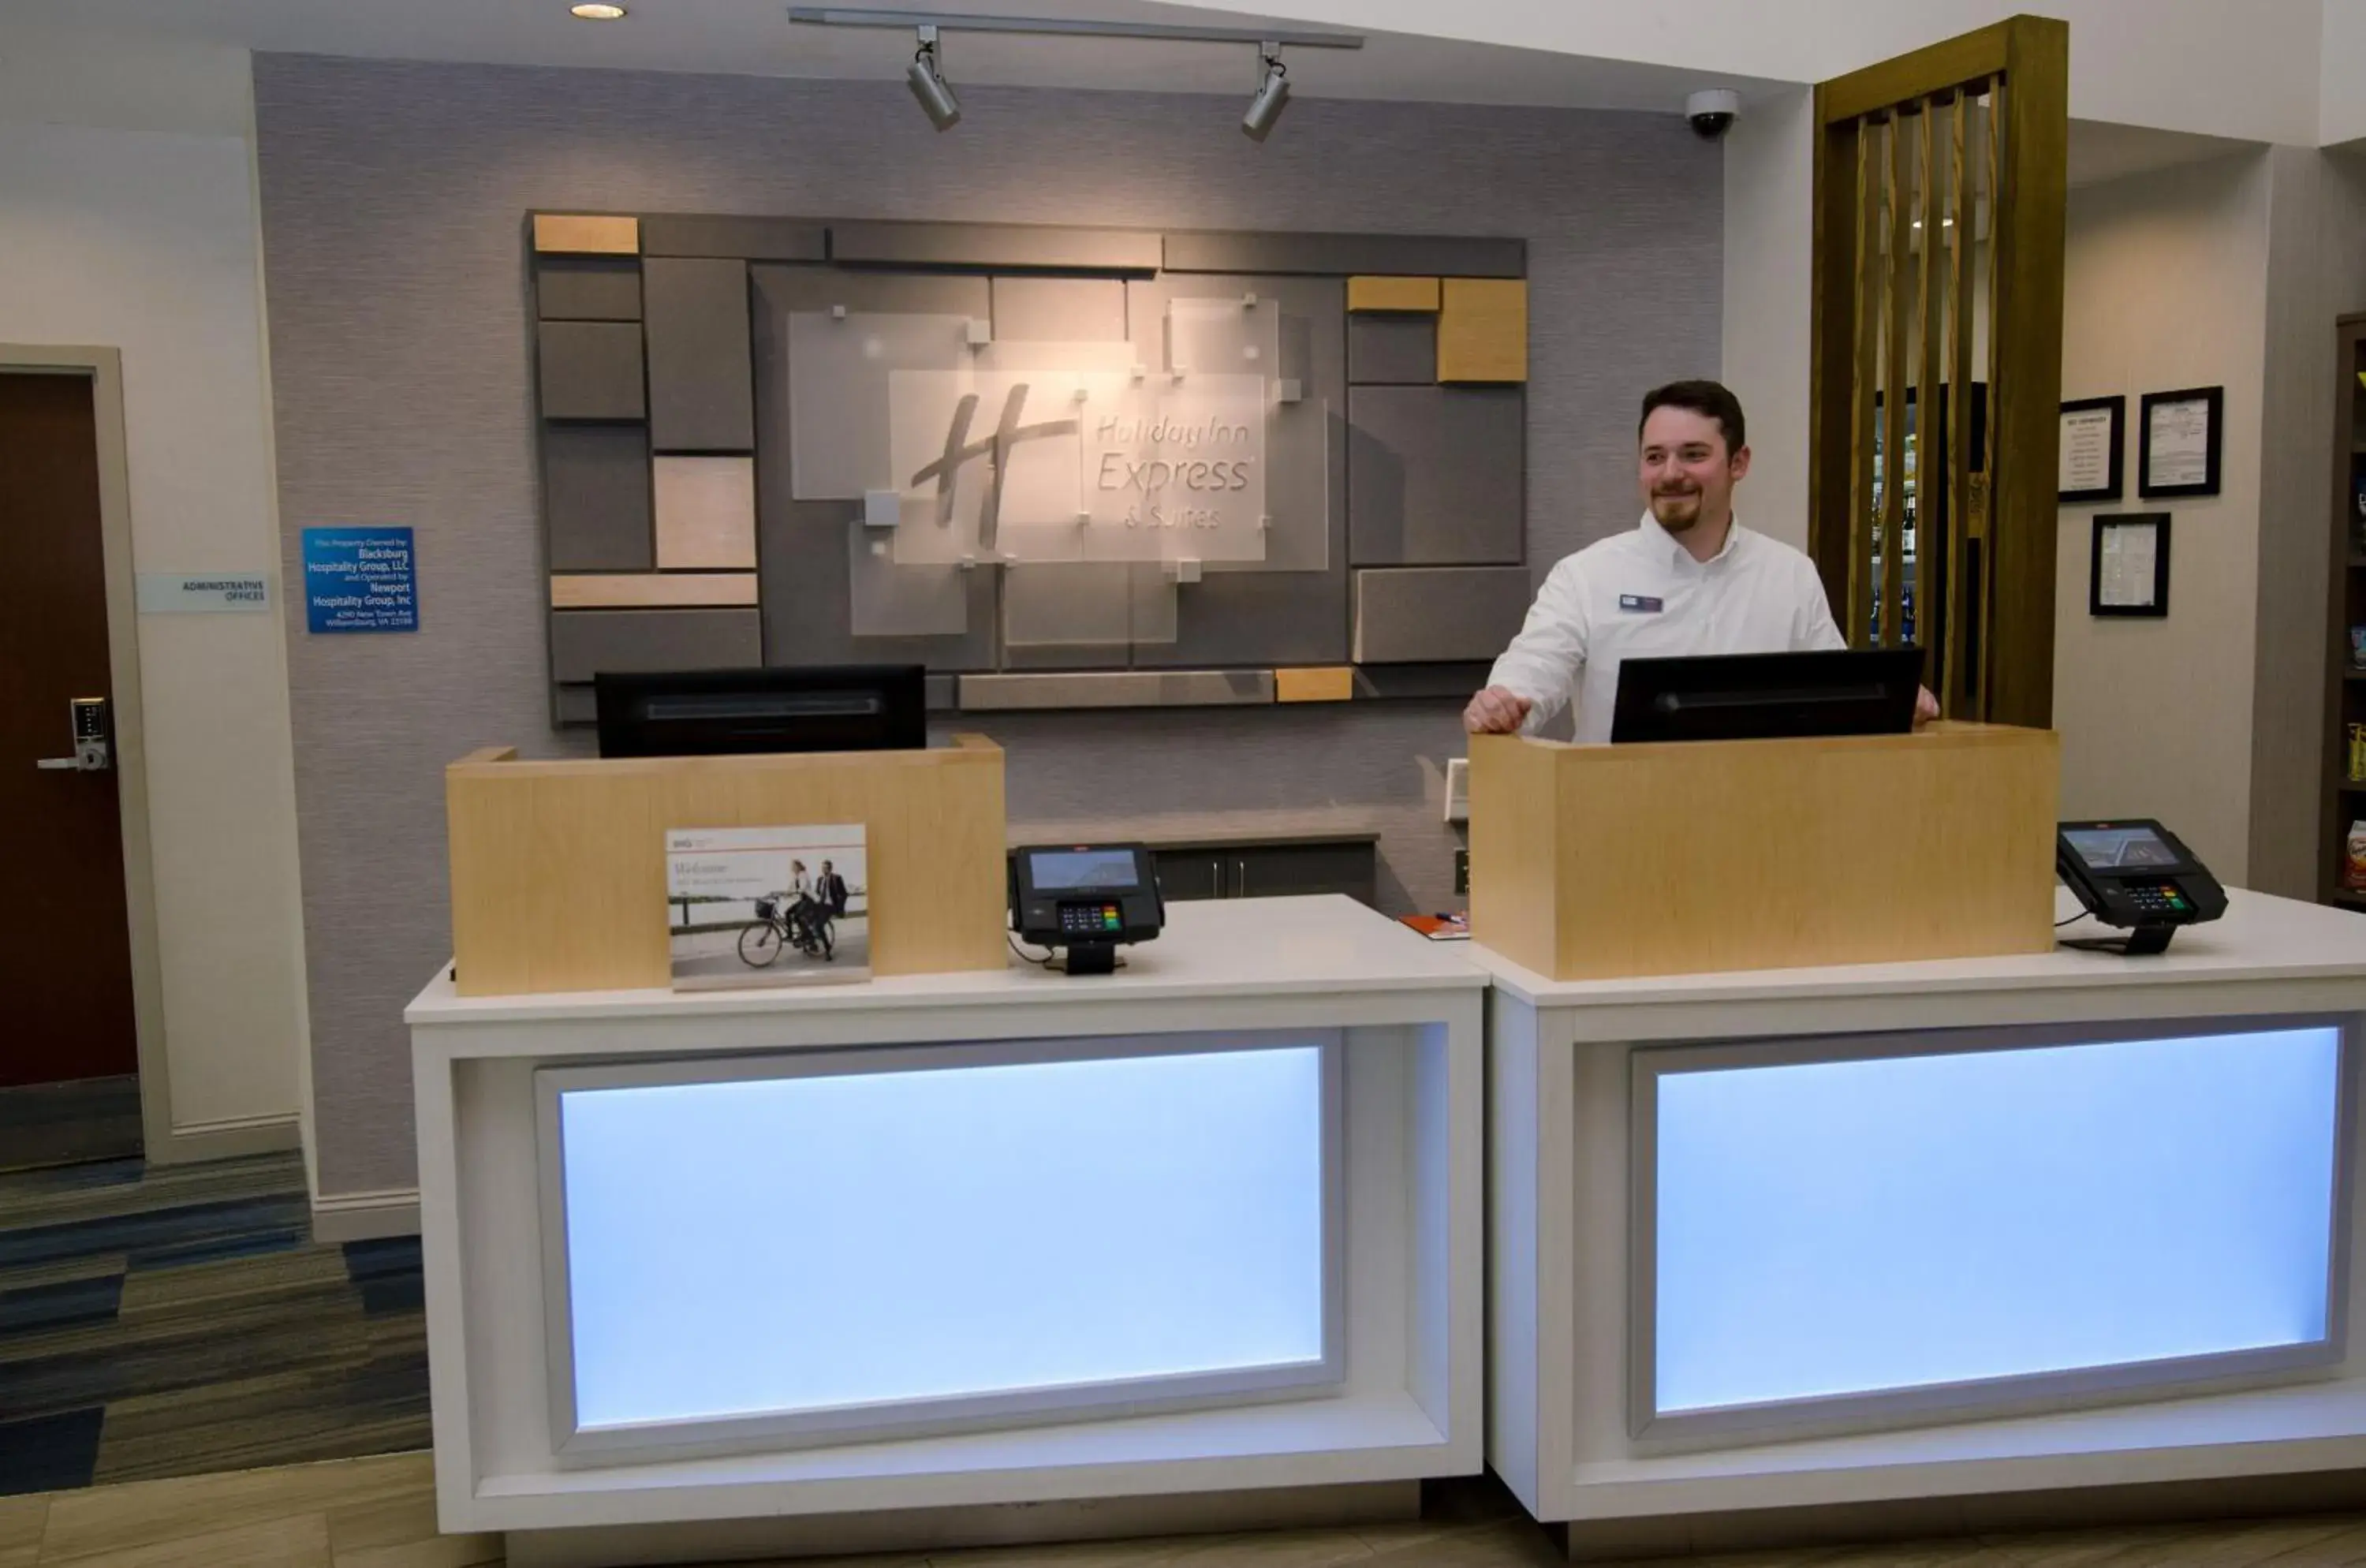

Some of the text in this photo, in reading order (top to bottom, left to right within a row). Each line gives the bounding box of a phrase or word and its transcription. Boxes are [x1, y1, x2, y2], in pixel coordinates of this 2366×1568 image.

[1097, 414, 1249, 449] Holiday Inn
[1098, 451, 1249, 501] Express
[1148, 503, 1222, 529] Suites
[359, 548, 408, 563] Blacksburg
[308, 562, 356, 574] Hospitality
[392, 561, 409, 570] LLC
[182, 581, 263, 592] ADMINISTRATIVE
[371, 583, 410, 595] Newport
[225, 592, 264, 602] OFFICES
[313, 595, 362, 608] Hospitality
